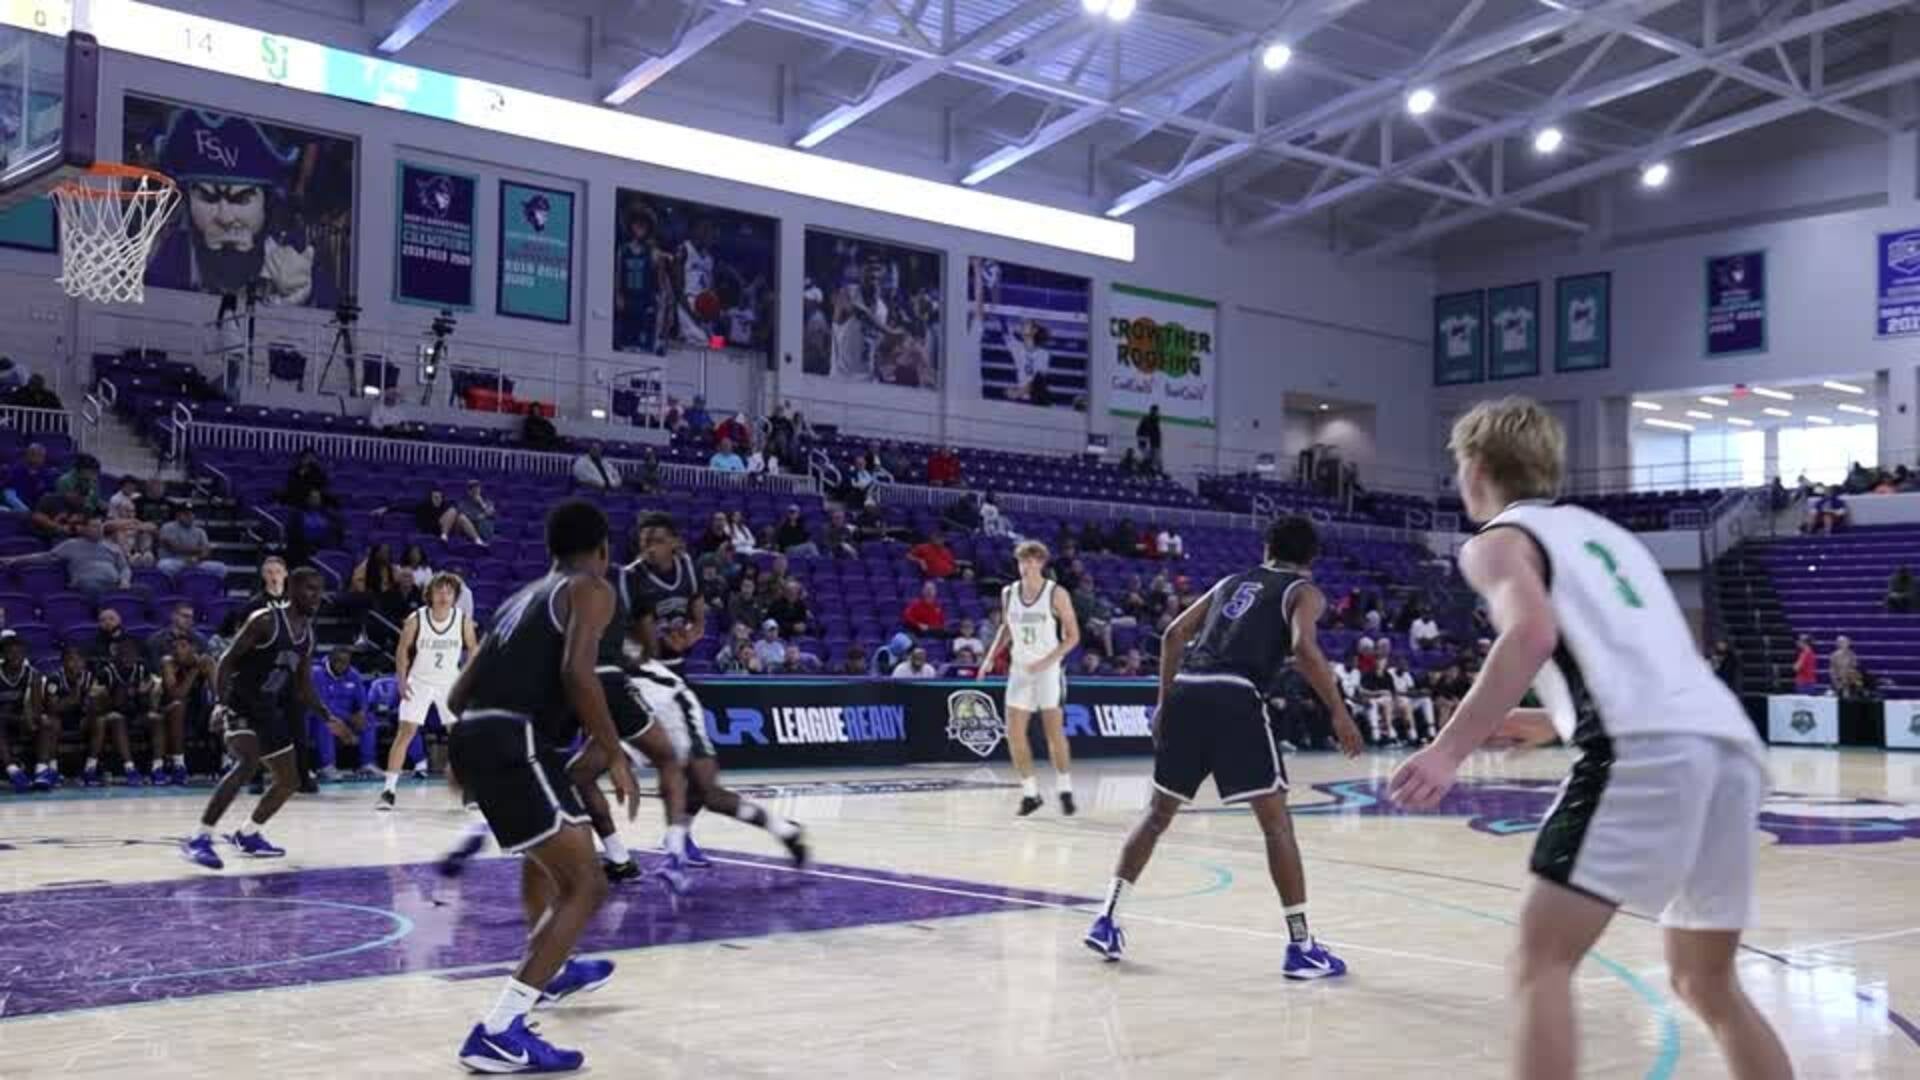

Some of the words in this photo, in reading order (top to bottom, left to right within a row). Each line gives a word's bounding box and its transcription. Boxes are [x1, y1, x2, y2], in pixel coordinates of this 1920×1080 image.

[184, 28, 213, 53] 14
[193, 129, 240, 168] FSW
[1109, 317, 1211, 354] CROWTHER
[1118, 344, 1201, 377] ROOFING
[1222, 581, 1264, 620] 5
[434, 652, 444, 669] 2
[1094, 704, 1158, 737] LEAGUE
